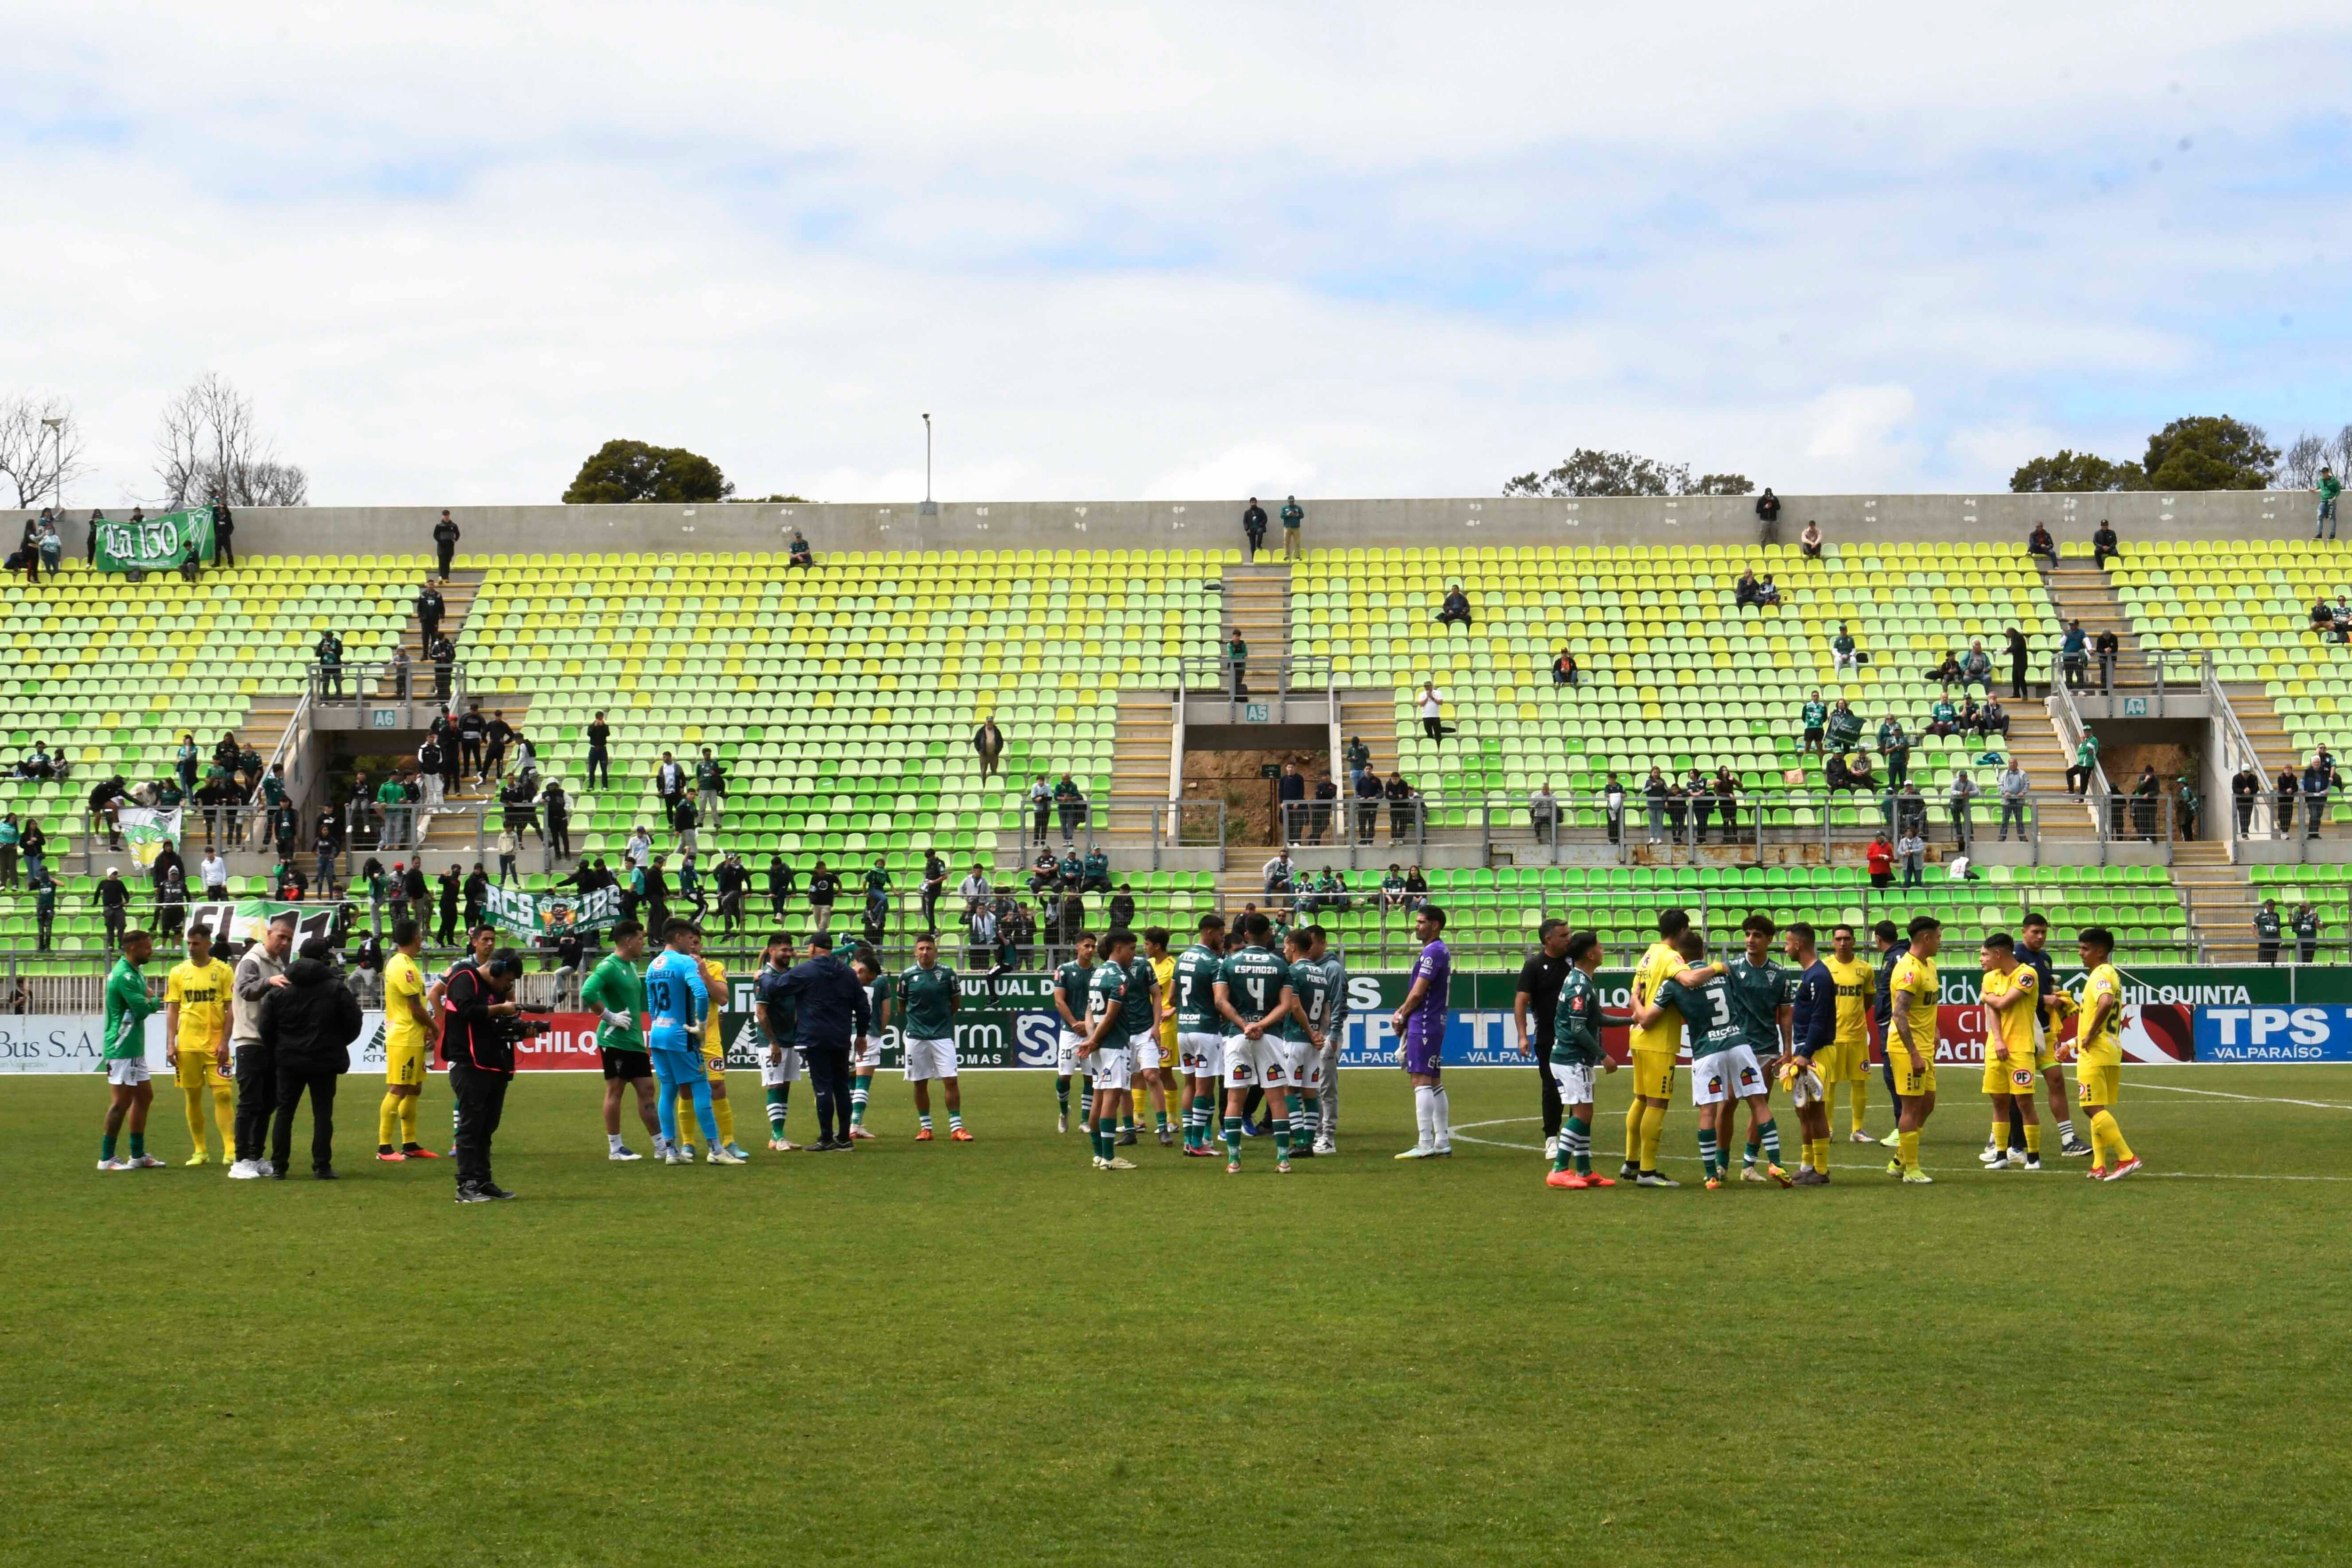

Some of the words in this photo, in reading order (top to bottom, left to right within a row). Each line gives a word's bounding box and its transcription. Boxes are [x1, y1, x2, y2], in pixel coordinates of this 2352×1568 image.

[139, 521, 178, 559] 150
[1248, 705, 1267, 720] A5
[2126, 699, 2145, 714] A4
[375, 711, 393, 725] A6
[1235, 965, 1278, 974] ESPINOZA
[1041, 979, 1055, 995] D
[2020, 976, 2031, 984] PF
[650, 981, 671, 1011] 13
[1180, 976, 1192, 1006] 7
[1247, 978, 1264, 1010] 4
[2122, 985, 2251, 1005] HILQUINTA
[1309, 989, 1324, 1020] 8
[1706, 988, 1730, 1026] 3
[1342, 1013, 1396, 1049] TP
[1459, 1013, 1535, 1049] TP
[1708, 1025, 1740, 1038] RICOH
[2206, 1008, 2330, 1044] TPS
[48, 1031, 102, 1058] S.A.
[2214, 1044, 2322, 1059] VALPARAÍSO
[364, 1054, 387, 1063] kno
[1061, 1049, 1072, 1059] 20
[1338, 1052, 1396, 1063] ALPAR
[713, 1060, 723, 1069] PF
[2016, 1073, 2027, 1082] PF
